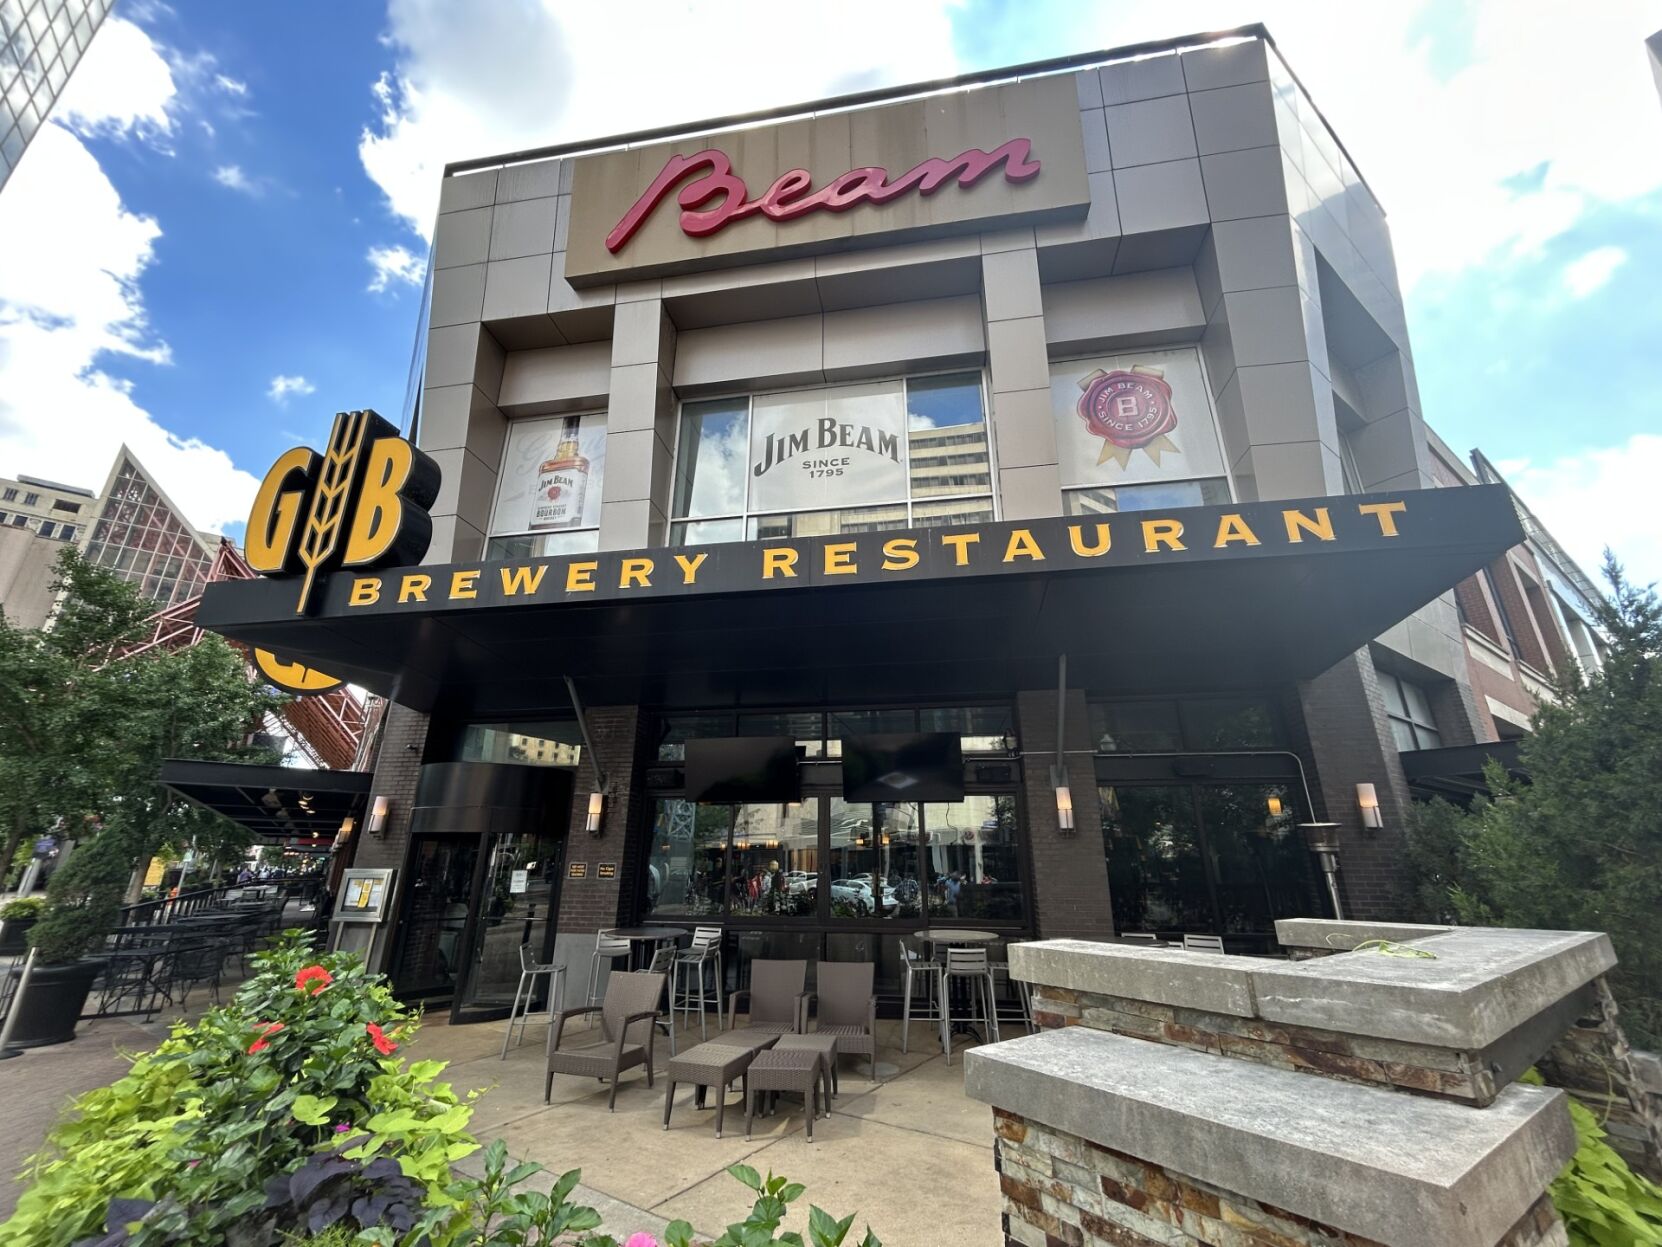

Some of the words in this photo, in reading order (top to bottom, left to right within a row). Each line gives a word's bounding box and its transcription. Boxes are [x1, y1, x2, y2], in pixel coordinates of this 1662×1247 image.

[604, 137, 1042, 254] Beam
[1098, 387, 1114, 403] JIM
[1117, 382, 1153, 399] BEAM
[1098, 411, 1133, 431] SINCE
[1137, 407, 1158, 428] 1795
[754, 428, 811, 477] JIM
[816, 417, 900, 464] BEAM
[802, 457, 850, 469] SINCE
[809, 468, 844, 478] 1795
[349, 553, 708, 606] BREWERY
[761, 501, 1407, 580] RESTAURANT
